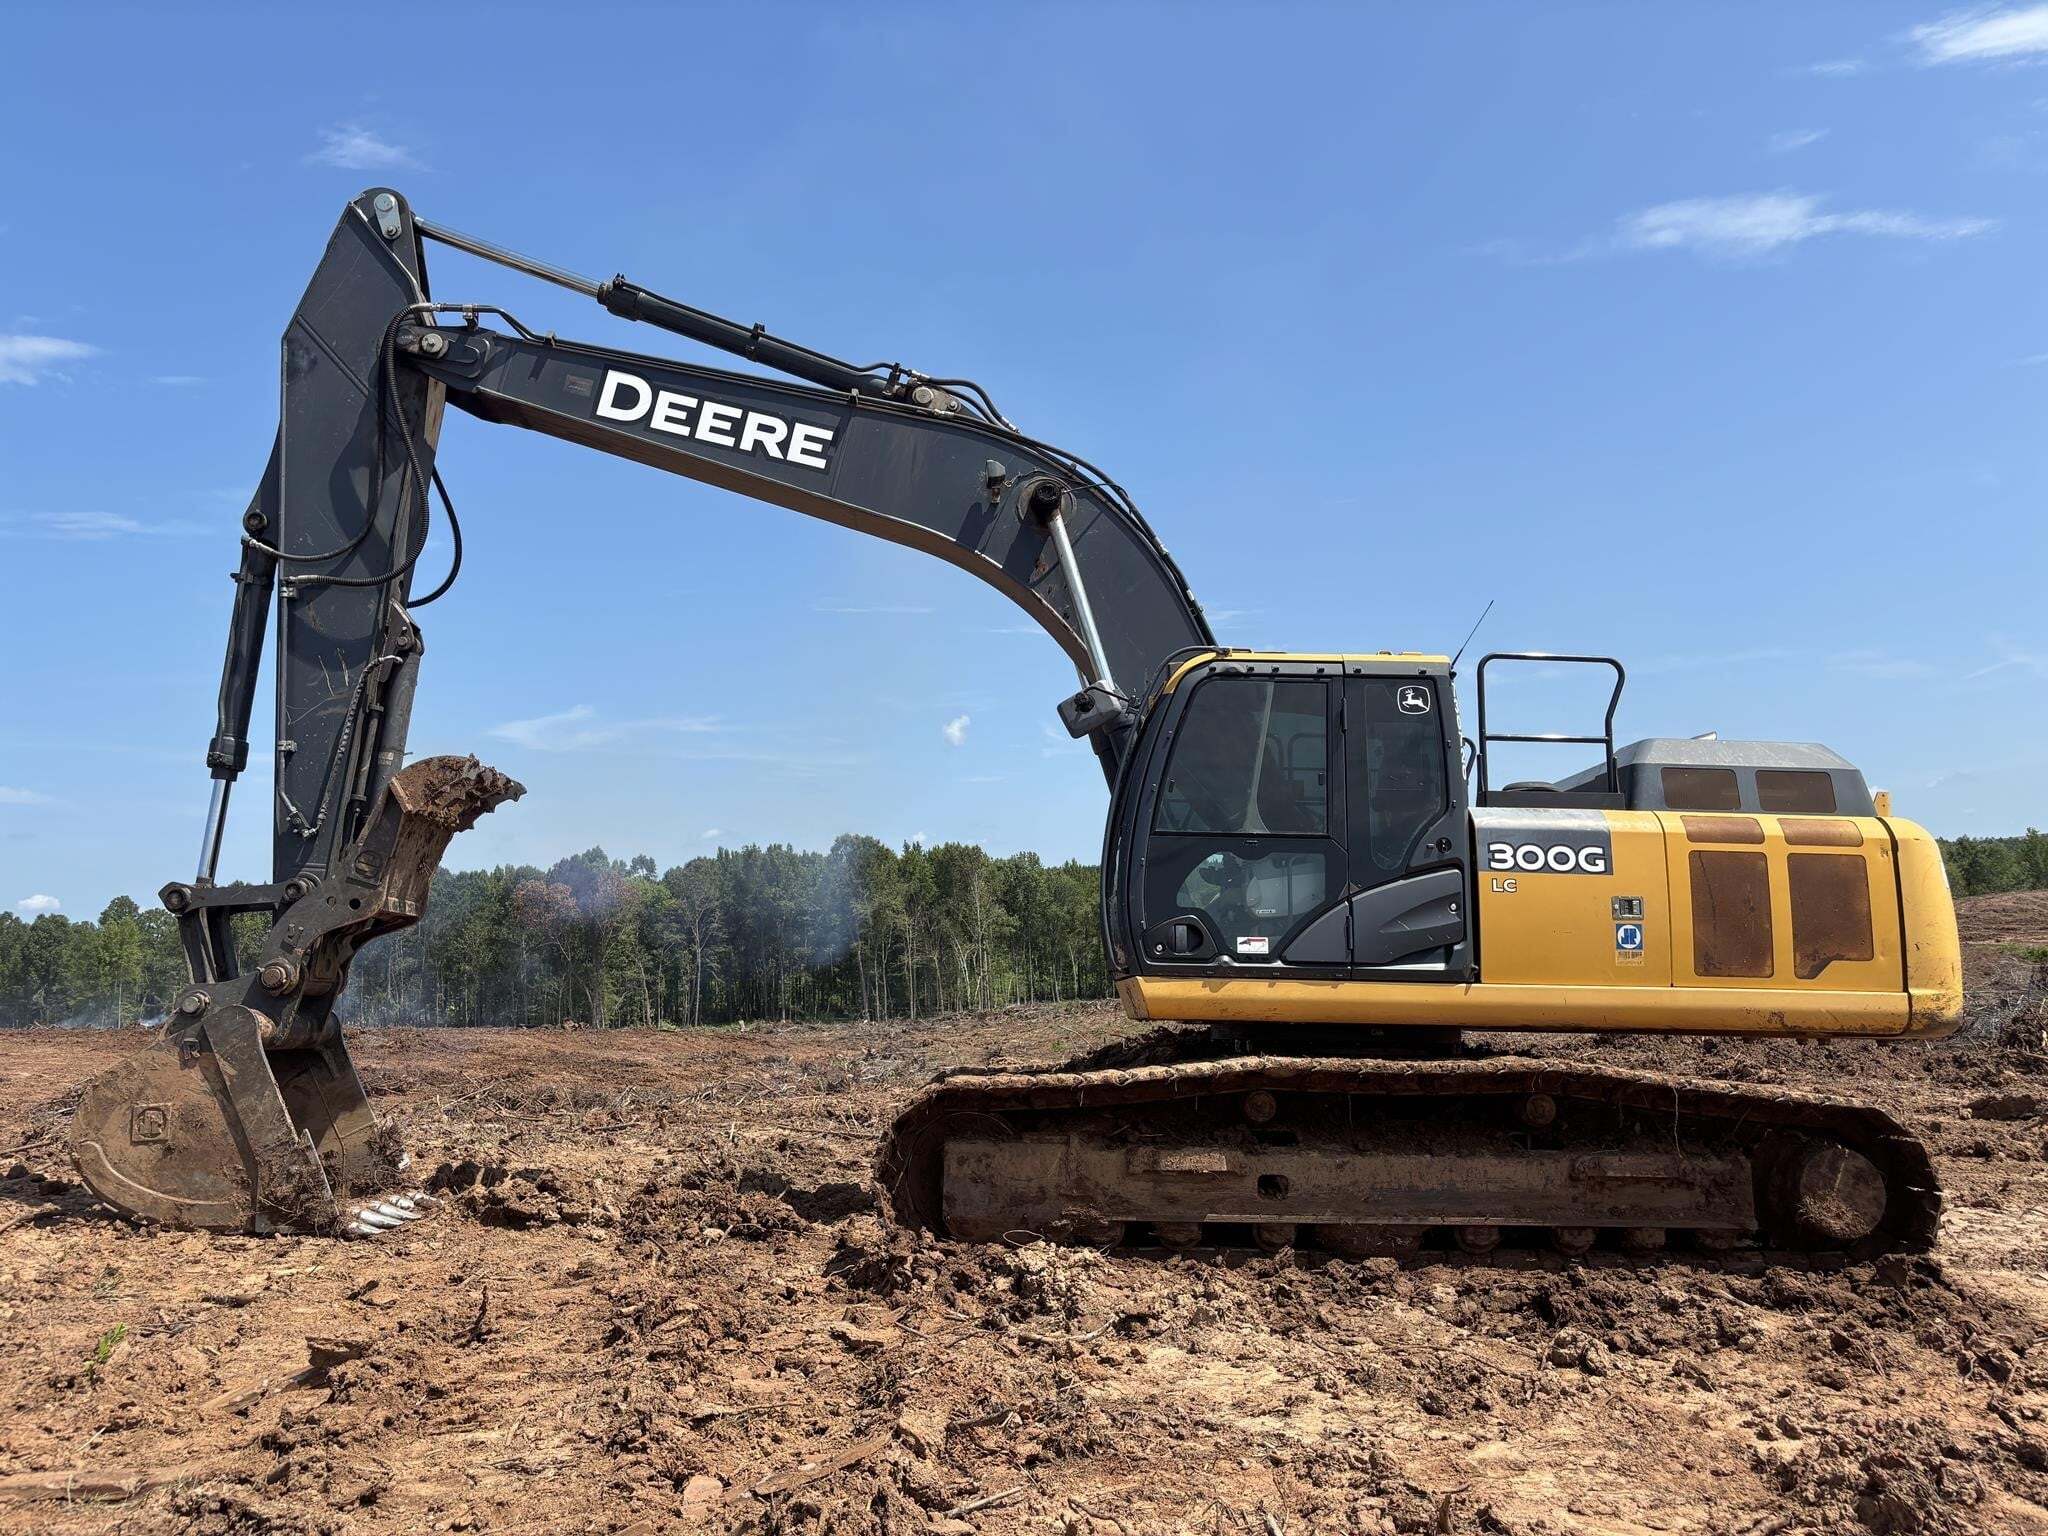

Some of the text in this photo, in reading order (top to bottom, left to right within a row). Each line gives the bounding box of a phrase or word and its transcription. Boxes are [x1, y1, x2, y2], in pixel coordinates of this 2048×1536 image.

[596, 369, 833, 469] DEERE
[1488, 842, 1606, 873] 300G
[1491, 878, 1517, 893] LC
